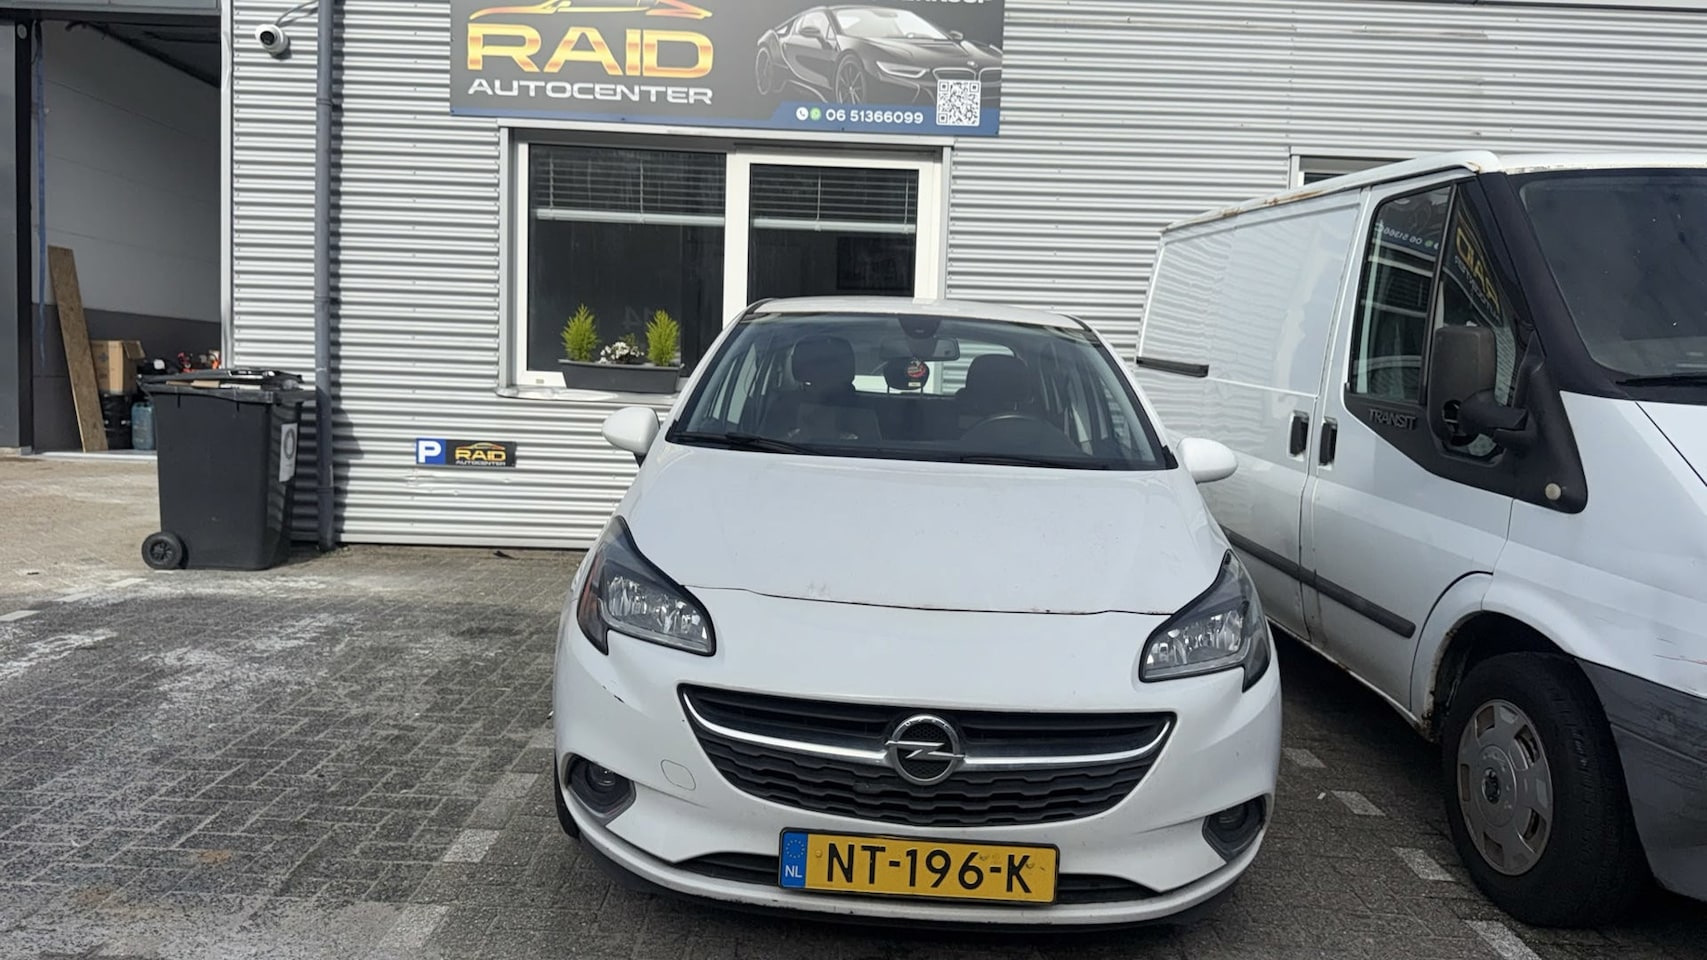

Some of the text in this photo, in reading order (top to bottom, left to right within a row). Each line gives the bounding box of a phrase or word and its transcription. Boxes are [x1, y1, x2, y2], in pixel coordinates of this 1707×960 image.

[467, 23, 713, 78] RAID
[467, 78, 713, 105] AUTOCENTER
[825, 108, 924, 124] 06 51366099
[1369, 408, 1416, 430] TRANSIT
[418, 440, 442, 463] P
[455, 449, 506, 461] RAID
[785, 865, 802, 878] NL
[827, 843, 1032, 893] NT-196-K
